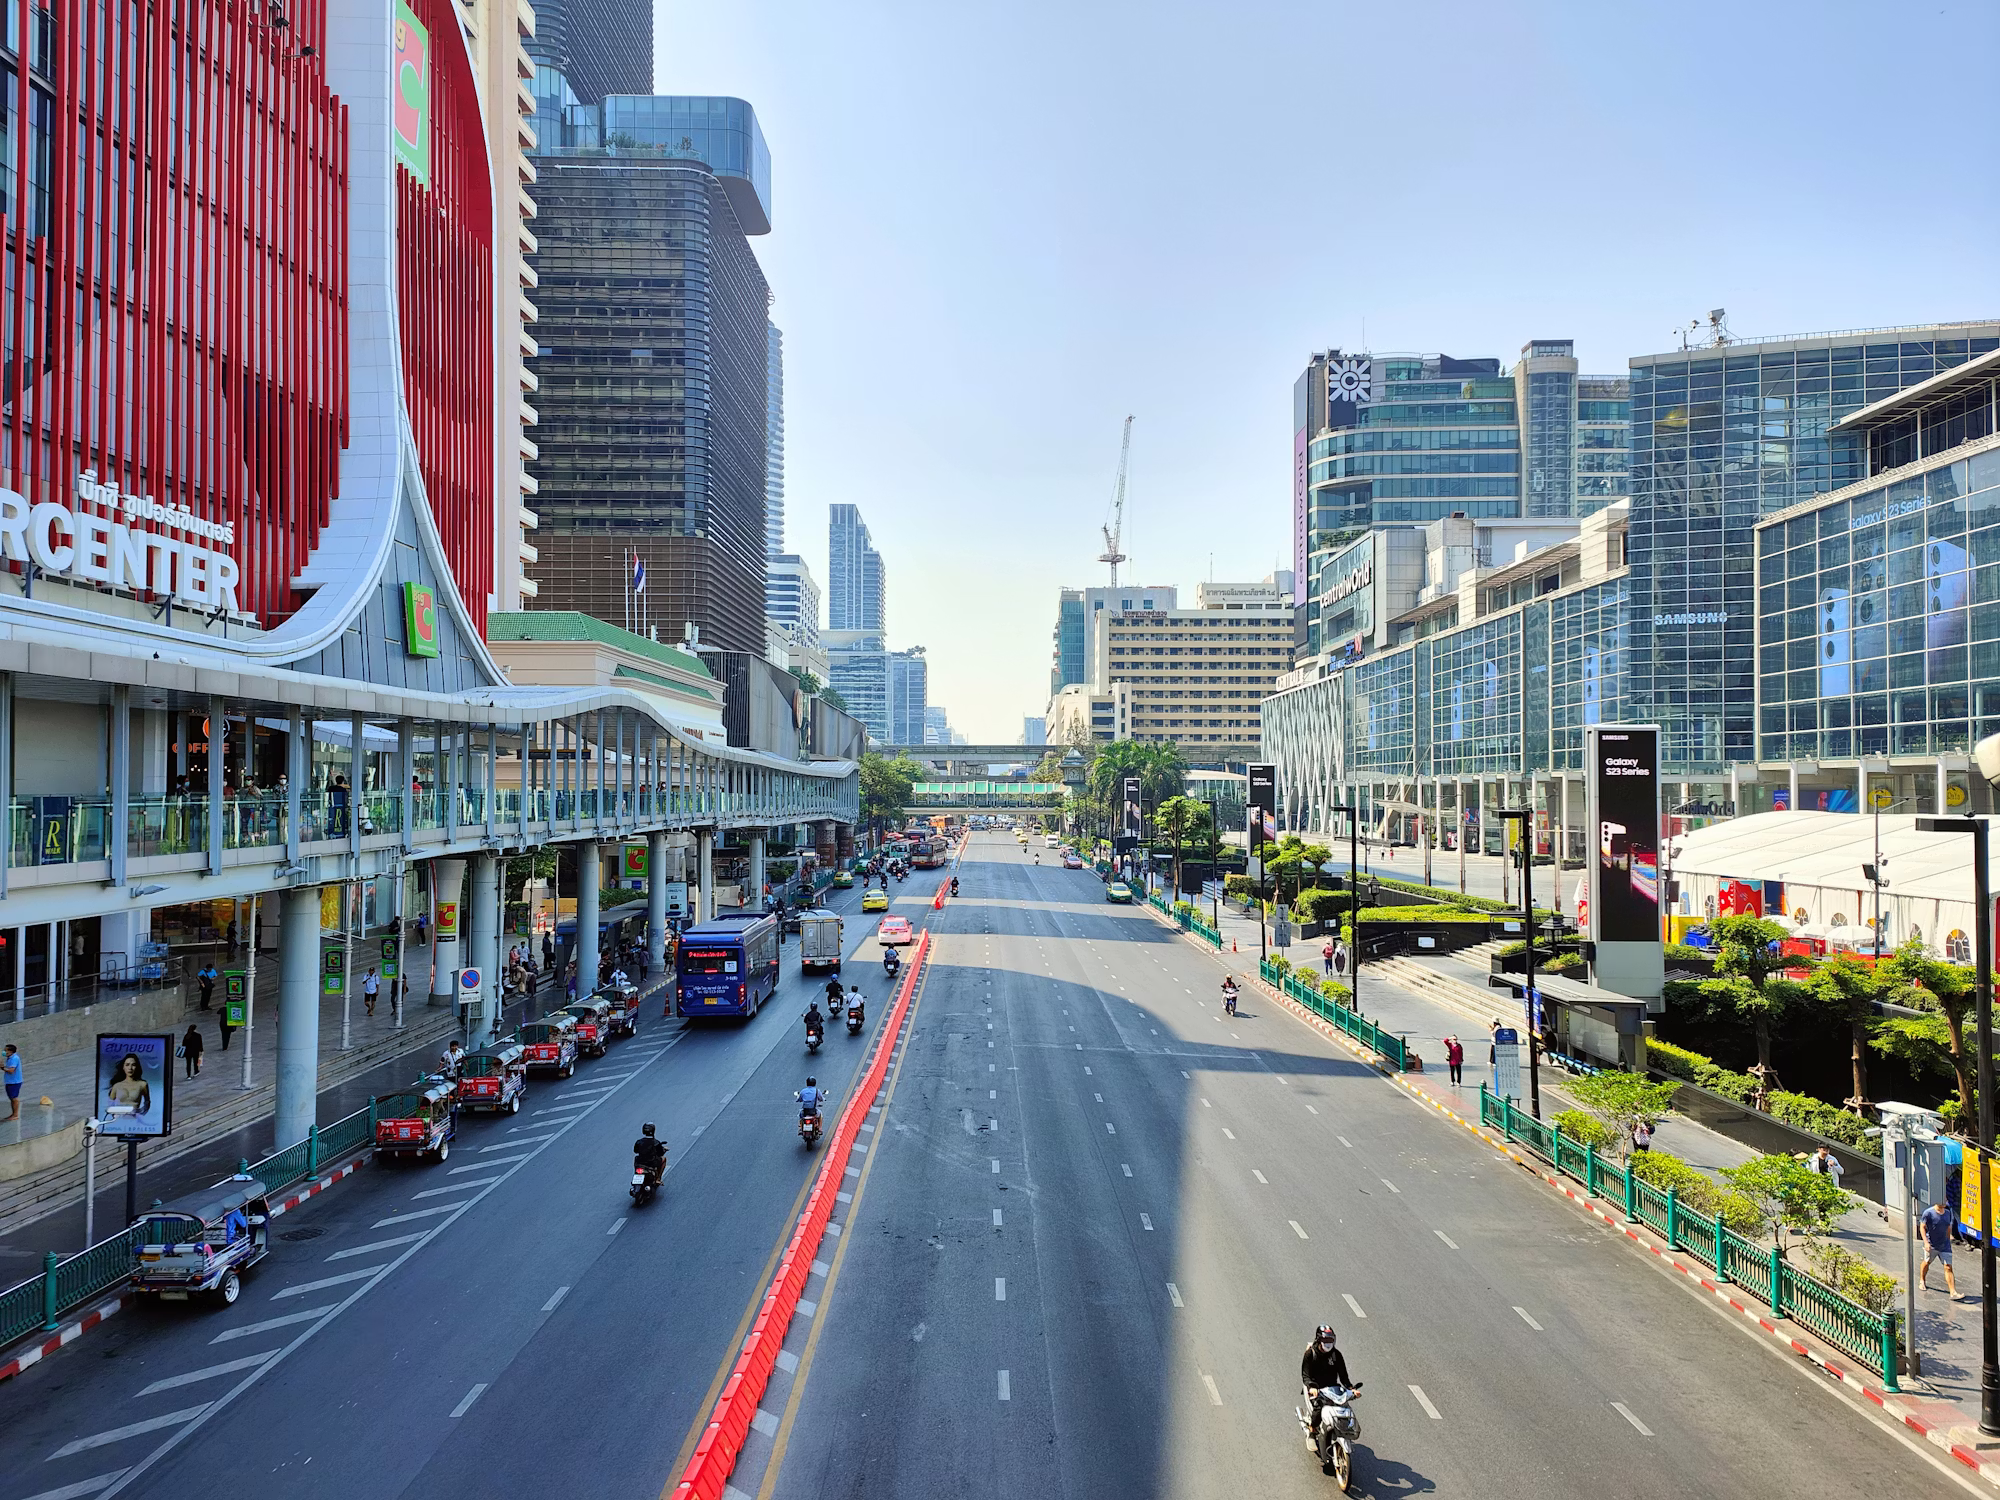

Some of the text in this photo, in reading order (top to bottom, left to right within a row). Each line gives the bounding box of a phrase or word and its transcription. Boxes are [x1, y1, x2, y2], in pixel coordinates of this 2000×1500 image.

[1848, 512, 1881, 531] Galaxy
[1900, 494, 1932, 515] Series
[1320, 560, 1370, 609] centralwOrld
[1655, 611, 1728, 626] SAMSUNG
[1605, 757, 1639, 767] Galaxy
[1605, 766, 1650, 776] S23 Series
[45, 820, 61, 848] R
